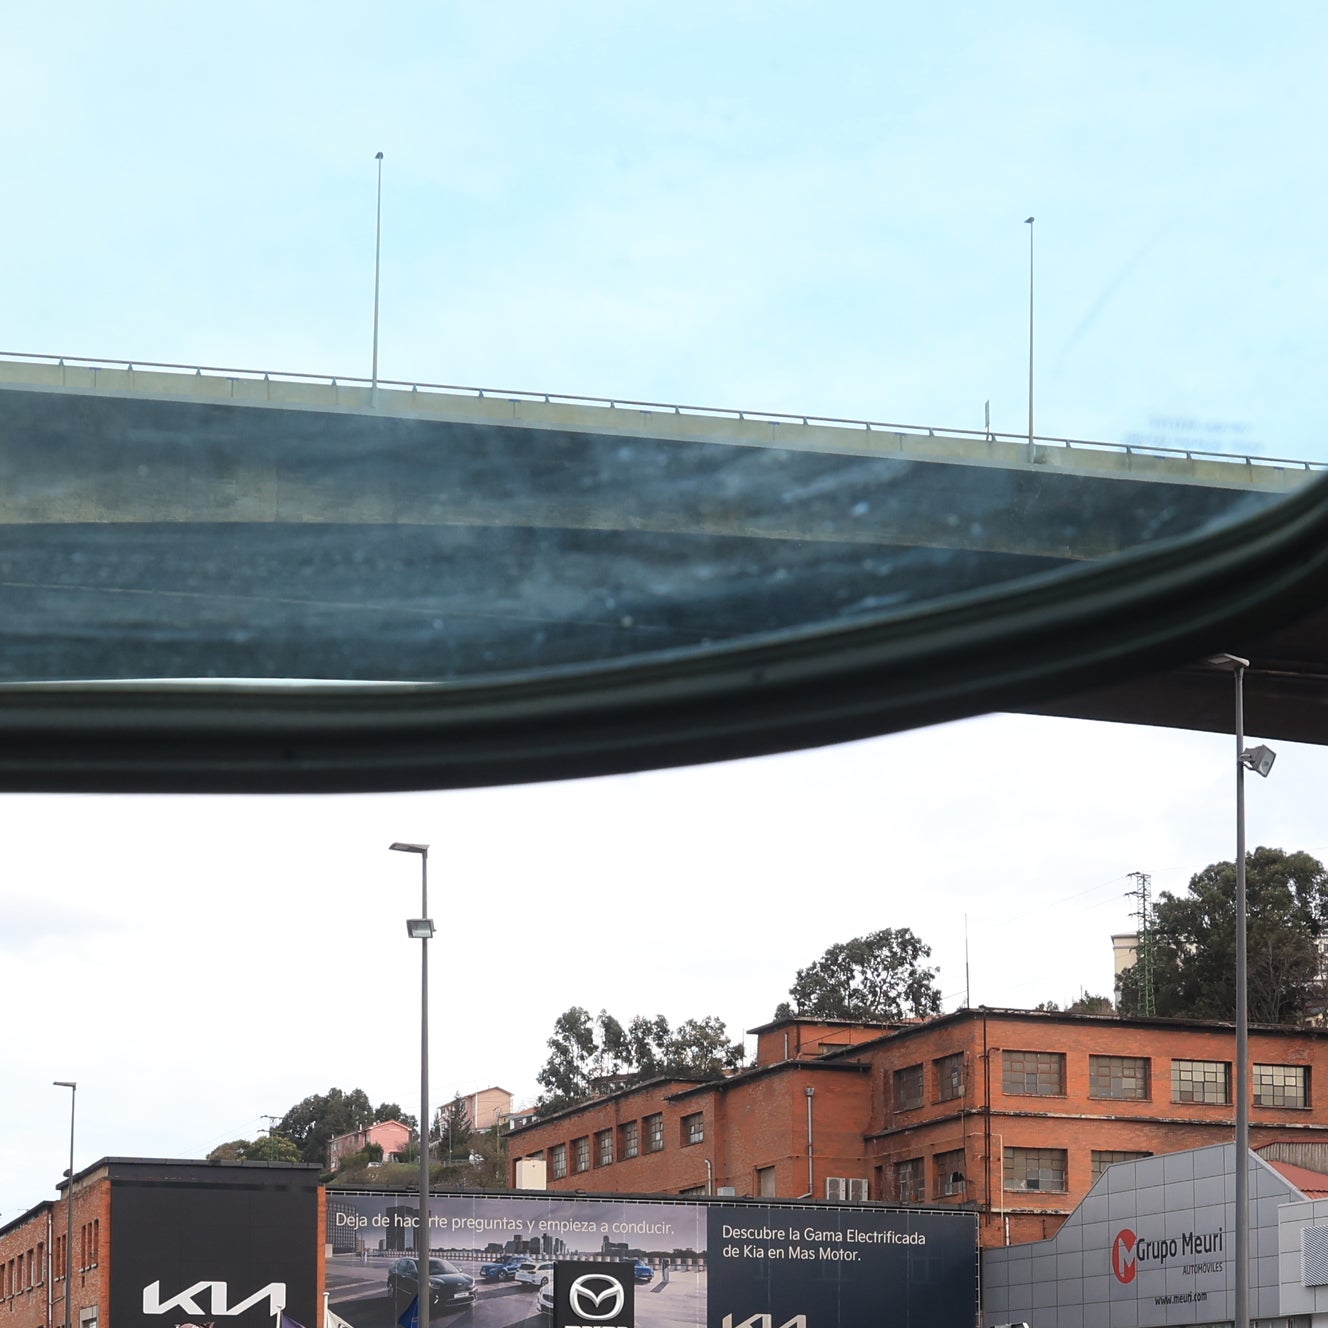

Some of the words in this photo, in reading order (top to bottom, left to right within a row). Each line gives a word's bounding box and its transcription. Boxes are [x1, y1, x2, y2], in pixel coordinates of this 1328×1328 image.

[335, 1212, 368, 1231] Deja
[371, 1213, 390, 1228] de
[393, 1214, 448, 1229] hacrte
[451, 1217, 523, 1234] preguntas
[527, 1220, 536, 1234] y
[538, 1218, 596, 1235] empieza
[600, 1221, 609, 1232] a
[612, 1219, 674, 1235] conducir.
[722, 1225, 785, 1241] Descubre
[789, 1227, 800, 1241] la
[804, 1228, 843, 1242] Gama
[847, 1229, 926, 1245] Electrificada
[723, 1245, 739, 1258] de
[744, 1245, 764, 1259] Kia
[768, 1249, 784, 1259] en
[788, 1247, 816, 1261] Mas
[819, 1247, 861, 1261] Motor.
[1136, 1238, 1178, 1264] Grupo
[1182, 1227, 1223, 1255] Meuri
[1154, 1291, 1208, 1306] www.meuri.com
